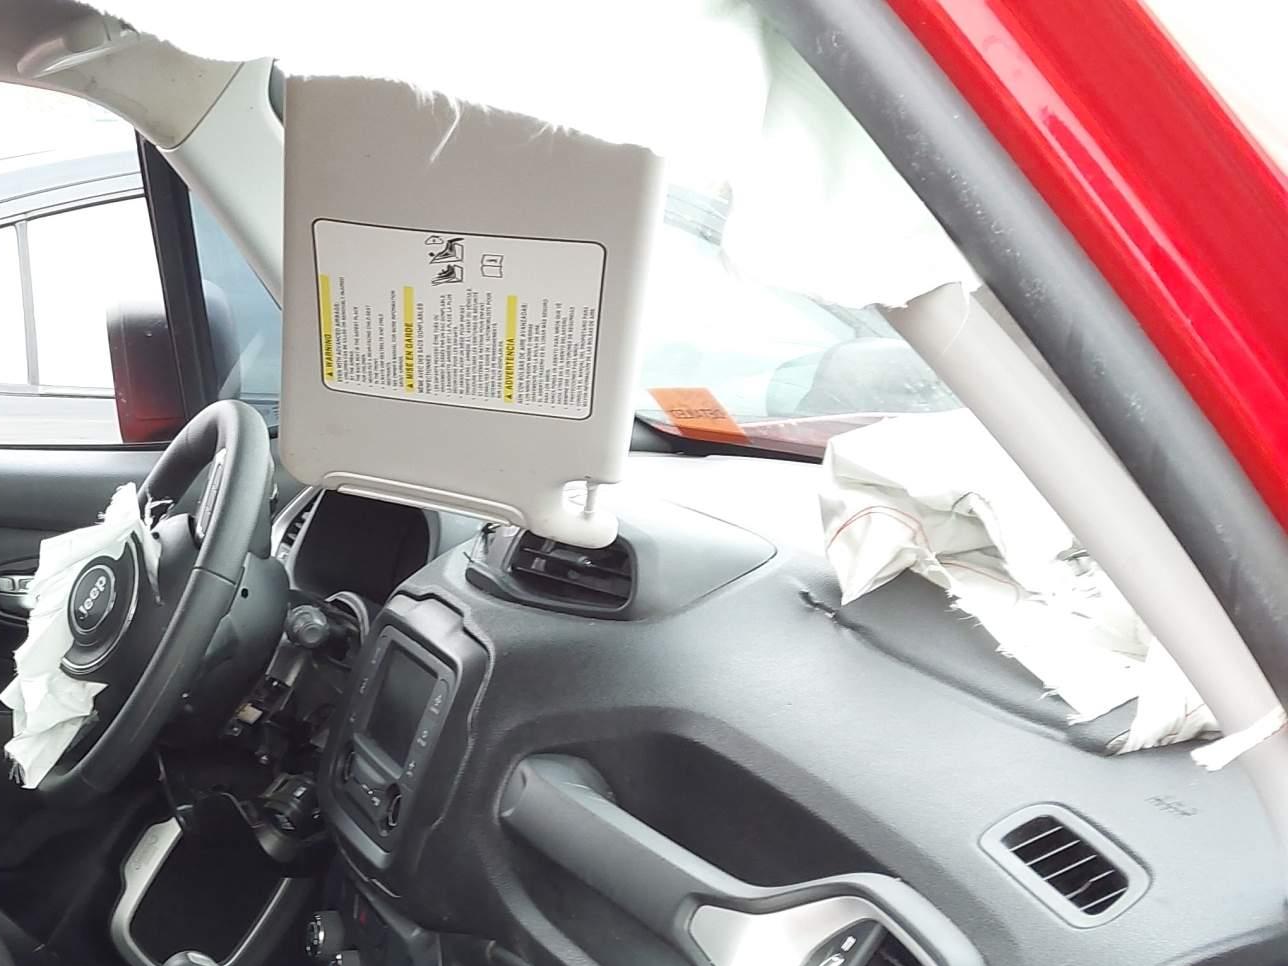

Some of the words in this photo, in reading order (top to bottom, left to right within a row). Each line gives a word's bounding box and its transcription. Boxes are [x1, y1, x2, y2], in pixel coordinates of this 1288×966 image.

[324, 333, 333, 367] WARNING
[404, 322, 413, 348] GARDE
[404, 350, 413, 360] EN
[505, 338, 514, 389] ADVERTENCIA
[404, 362, 413, 379] MISE
[78, 575, 107, 620] Jeep
